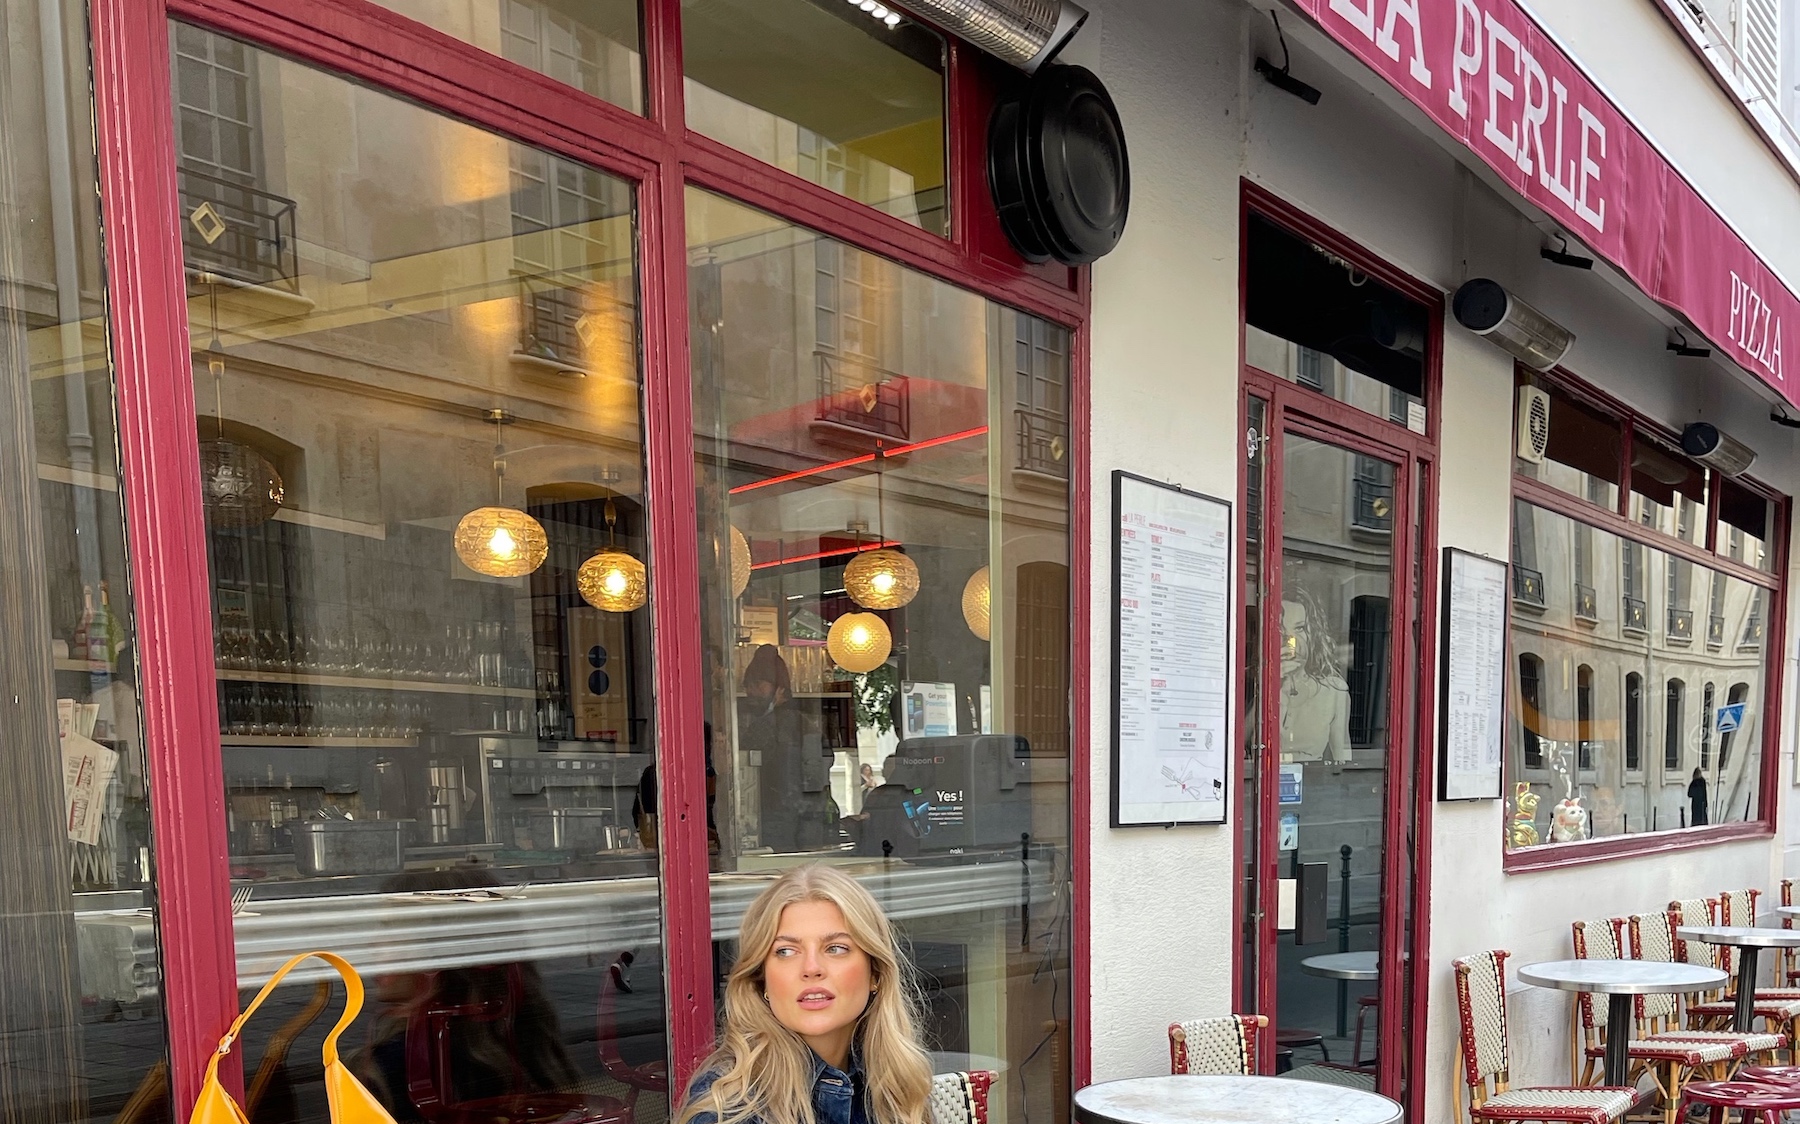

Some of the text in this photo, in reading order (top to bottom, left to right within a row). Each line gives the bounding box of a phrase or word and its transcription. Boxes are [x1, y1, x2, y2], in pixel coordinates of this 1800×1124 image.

[1329, 0, 1606, 234] A PERLE
[1727, 270, 1783, 380] PIZZA
